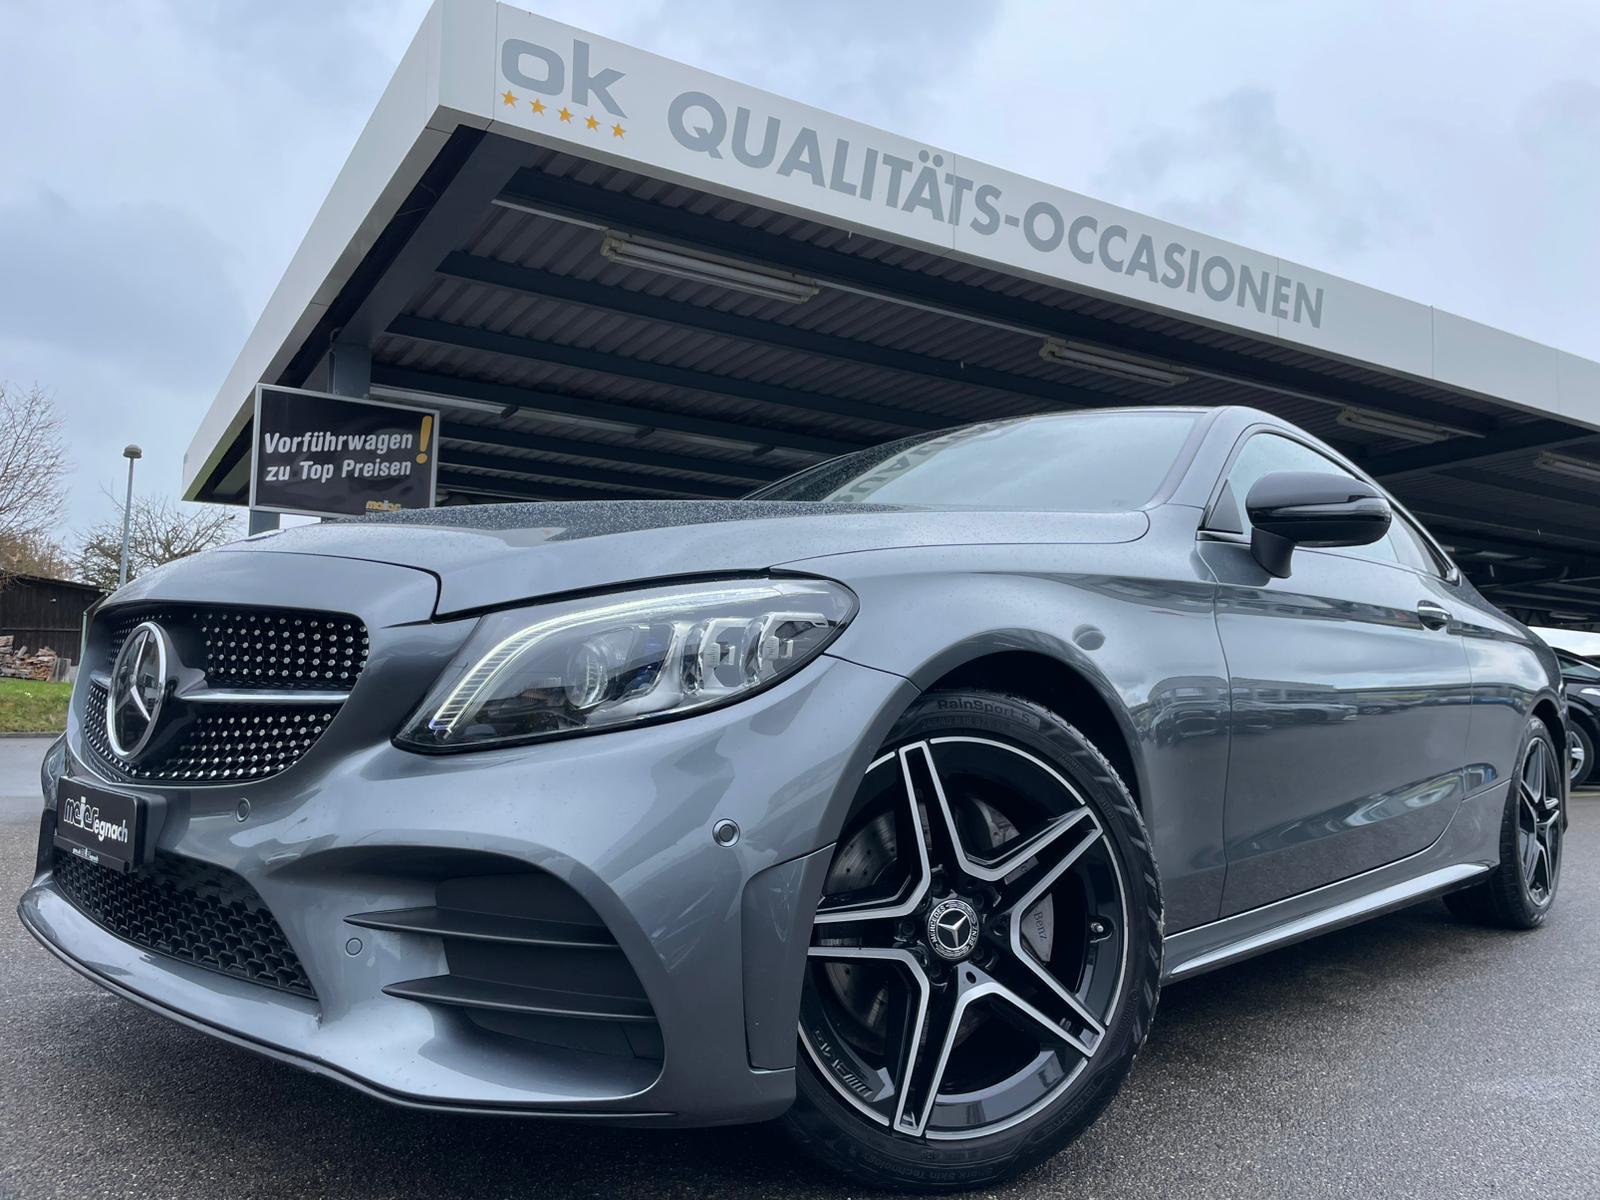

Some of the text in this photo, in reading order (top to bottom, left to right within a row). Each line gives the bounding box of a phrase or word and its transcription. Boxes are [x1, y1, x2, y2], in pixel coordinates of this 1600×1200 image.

[501, 38, 628, 119] ok
[667, 91, 1324, 328] QUALITÄTS-OCCASIONEN
[264, 432, 413, 454] Vorführwagen
[265, 459, 411, 483] zu Top Preisen
[937, 698, 1015, 717] RainSport
[929, 904, 946, 943] MERCEDES
